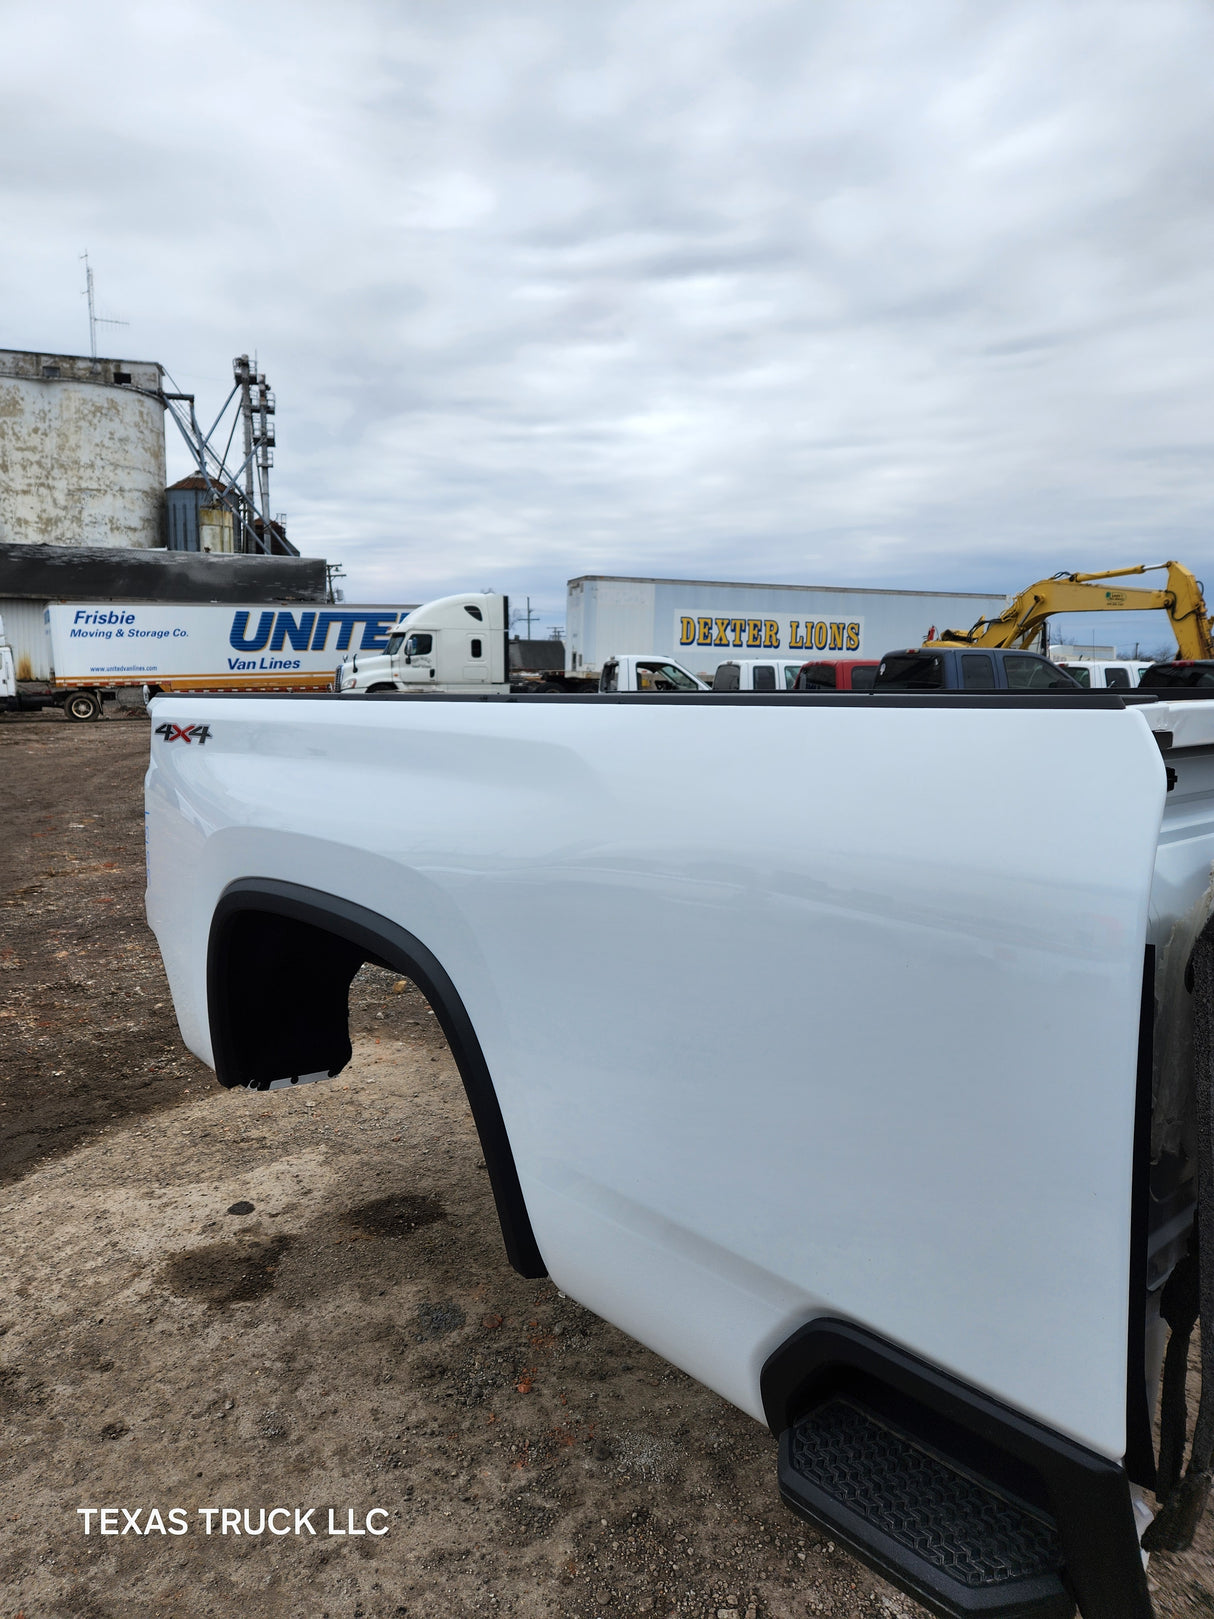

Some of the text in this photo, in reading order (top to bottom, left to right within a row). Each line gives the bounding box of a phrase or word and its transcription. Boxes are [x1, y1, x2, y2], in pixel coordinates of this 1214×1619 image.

[73, 610, 136, 625] Frisbie
[69, 628, 189, 640] Moving & Storage Co.
[229, 611, 411, 653] UNITE
[679, 616, 861, 652] DEXTER LIONS
[227, 657, 301, 671] Van Lines
